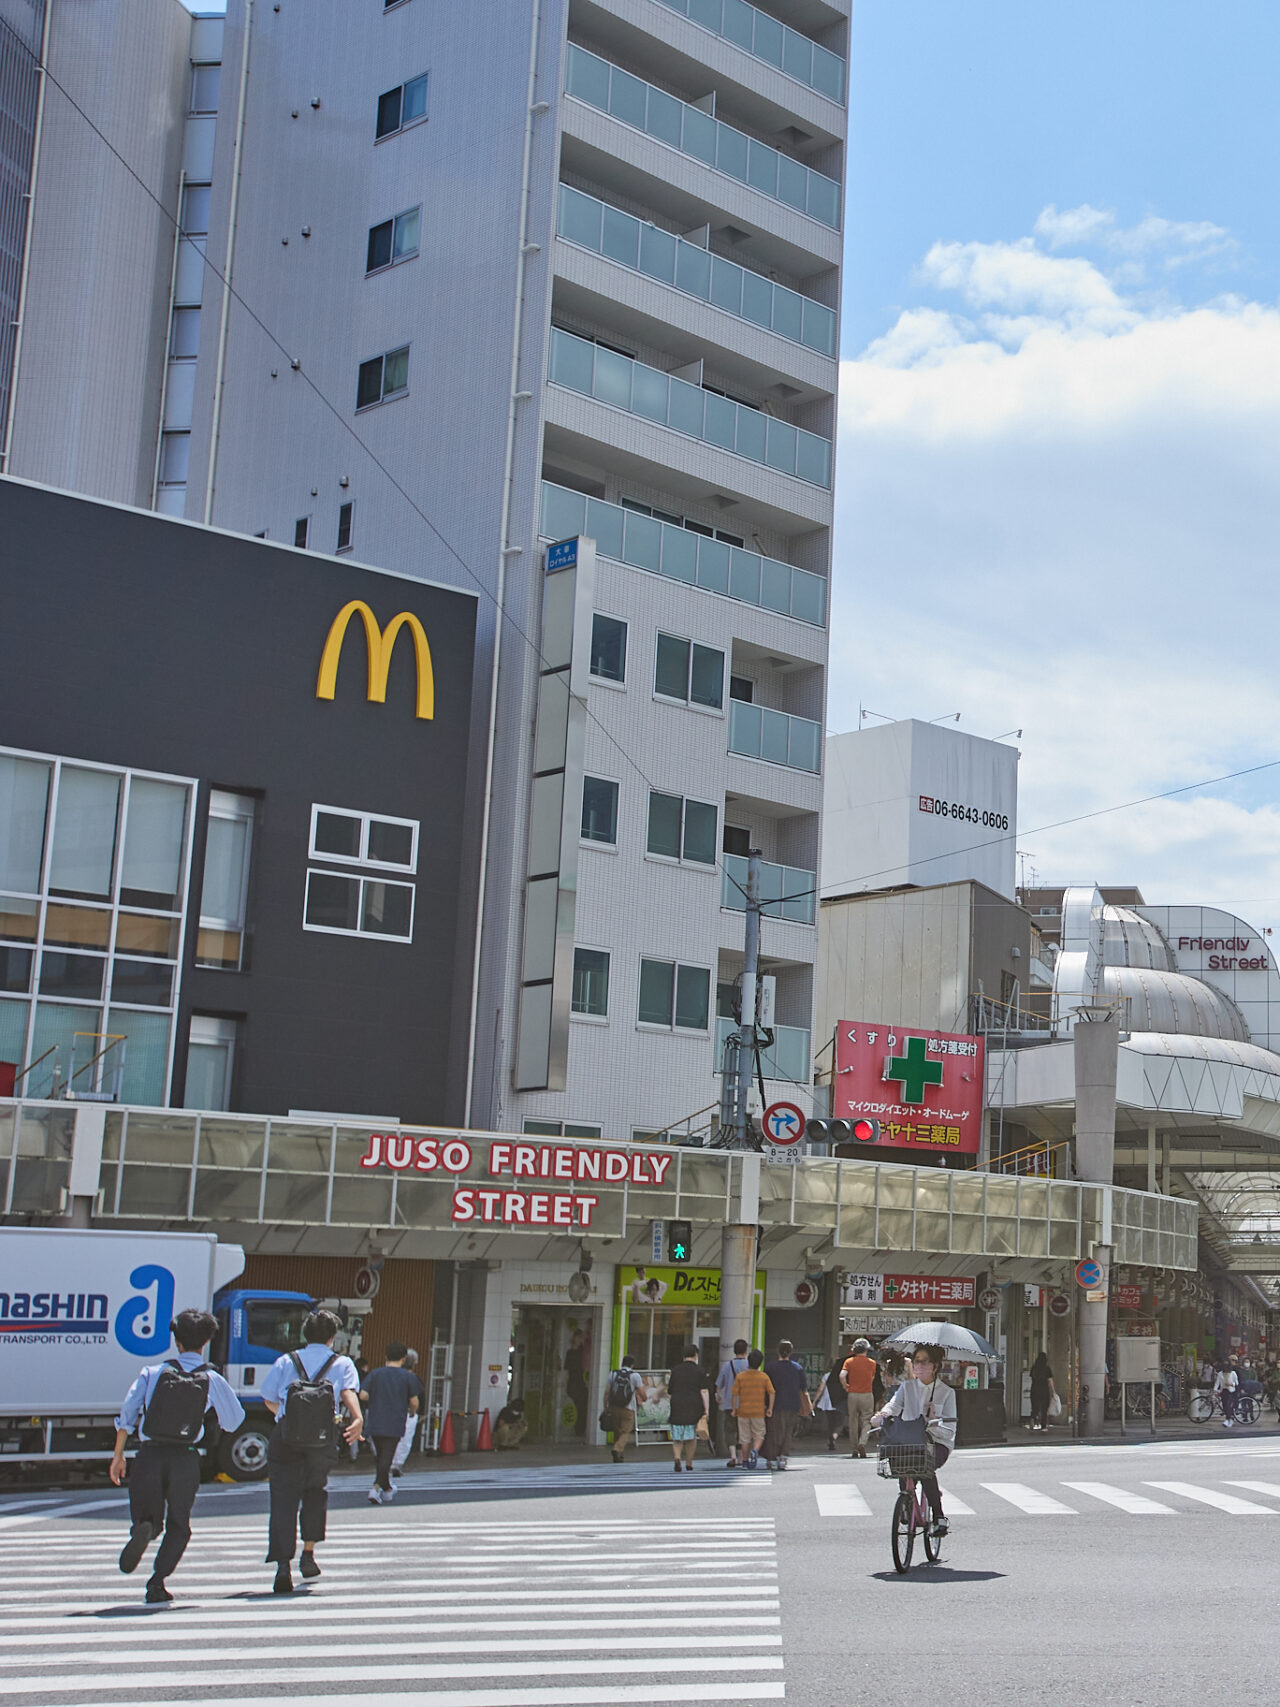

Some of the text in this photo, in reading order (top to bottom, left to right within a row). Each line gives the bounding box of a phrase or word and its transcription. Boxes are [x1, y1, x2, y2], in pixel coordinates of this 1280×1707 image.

[1178, 936, 1250, 951] Friendly
[1208, 955, 1268, 970] Street
[847, 1029, 897, 1047] くすり
[361, 1134, 672, 1185] JUSO FRIENDLY
[451, 1189, 599, 1227] STREET
[850, 1275, 882, 1288] 処方せん
[853, 1289, 877, 1301] 調剤
[900, 1280, 974, 1300] タキヤ十三薬局
